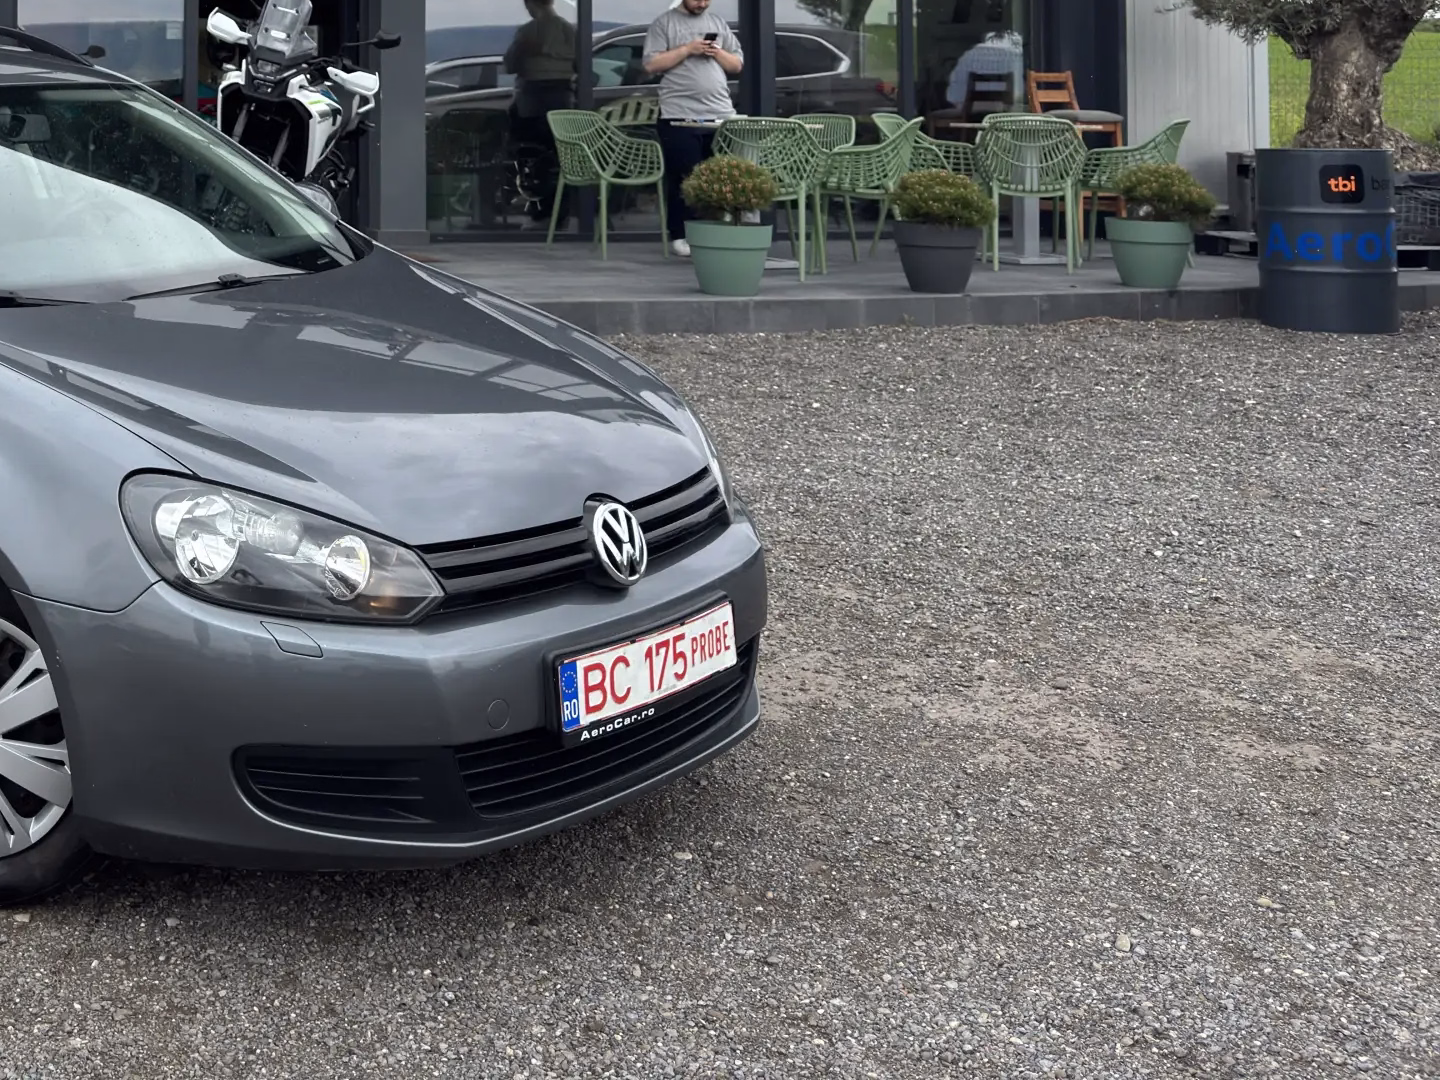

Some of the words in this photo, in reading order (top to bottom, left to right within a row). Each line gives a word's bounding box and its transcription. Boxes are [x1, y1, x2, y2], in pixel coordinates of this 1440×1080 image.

[1328, 176, 1356, 193] tbi
[583, 655, 633, 716] BC
[644, 632, 688, 694] 175
[691, 620, 731, 668] PROBE
[563, 699, 579, 722] RO
[580, 707, 656, 741] AeroCar.ro
